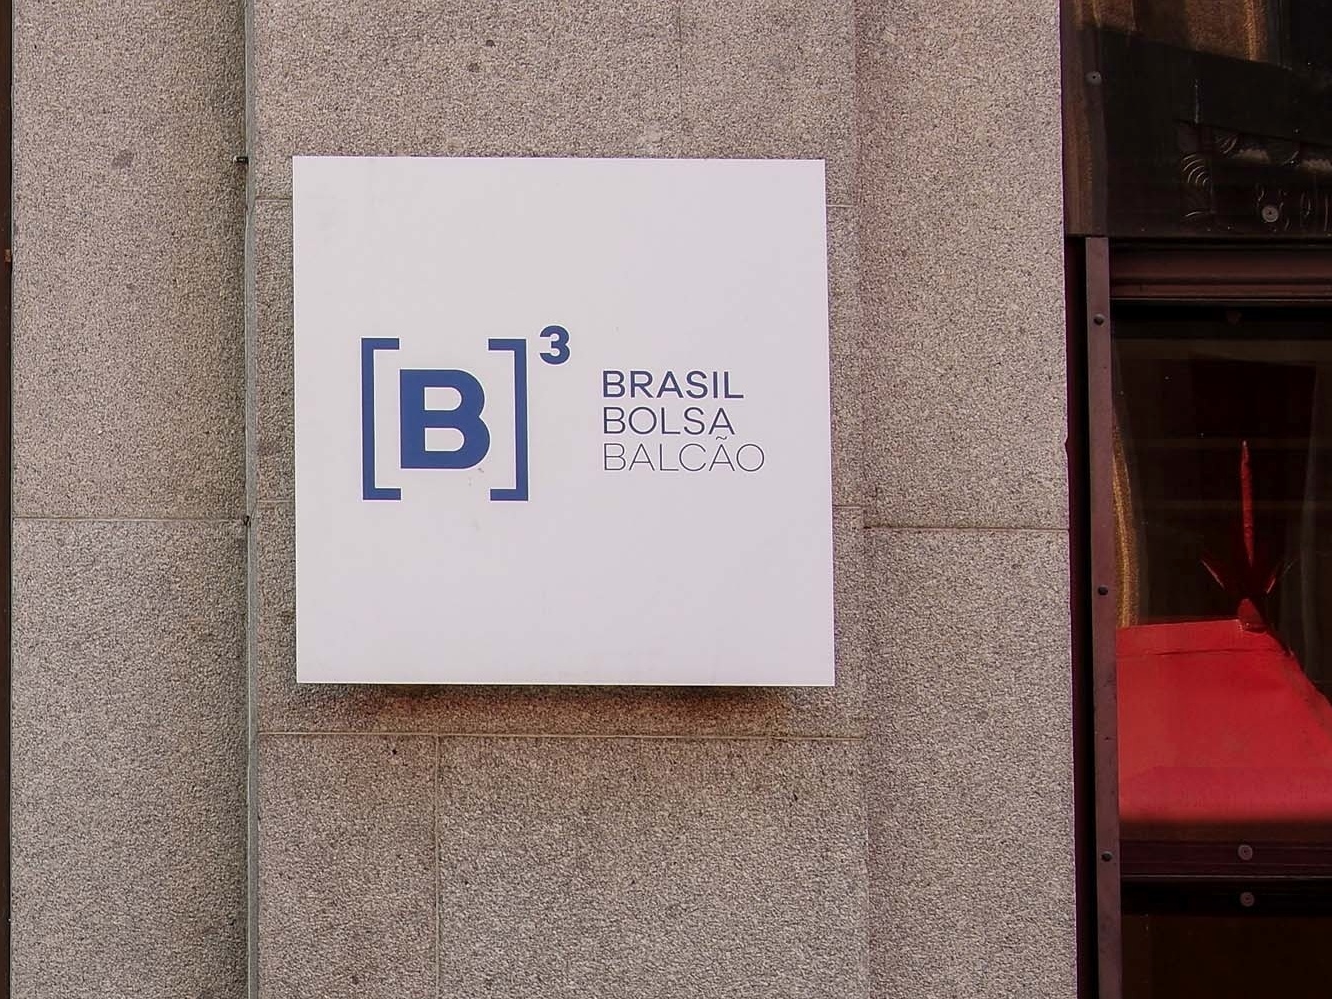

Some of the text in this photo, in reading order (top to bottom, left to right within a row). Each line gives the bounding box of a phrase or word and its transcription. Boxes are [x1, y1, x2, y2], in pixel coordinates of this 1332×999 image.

[602, 369, 744, 400] BRASIL
[602, 406, 736, 436] BOLSA
[603, 435, 765, 473] BALCÃO
